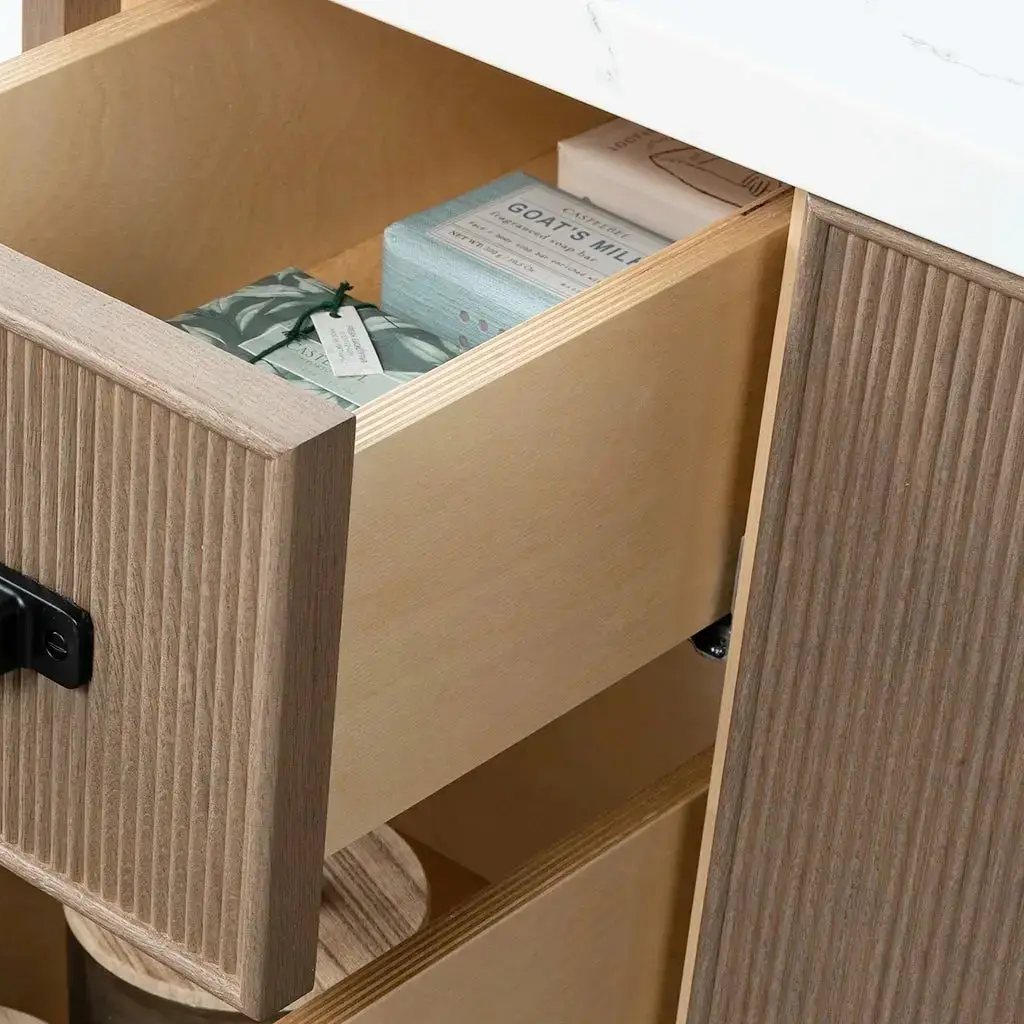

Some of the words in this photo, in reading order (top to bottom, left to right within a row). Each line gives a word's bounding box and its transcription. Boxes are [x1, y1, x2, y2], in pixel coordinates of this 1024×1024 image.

[489, 211, 551, 240] fragranced
[550, 239, 576, 253] soap
[577, 250, 597, 262] bar
[507, 203, 590, 241] GOAT'S
[562, 207, 630, 239] CASTELBEL
